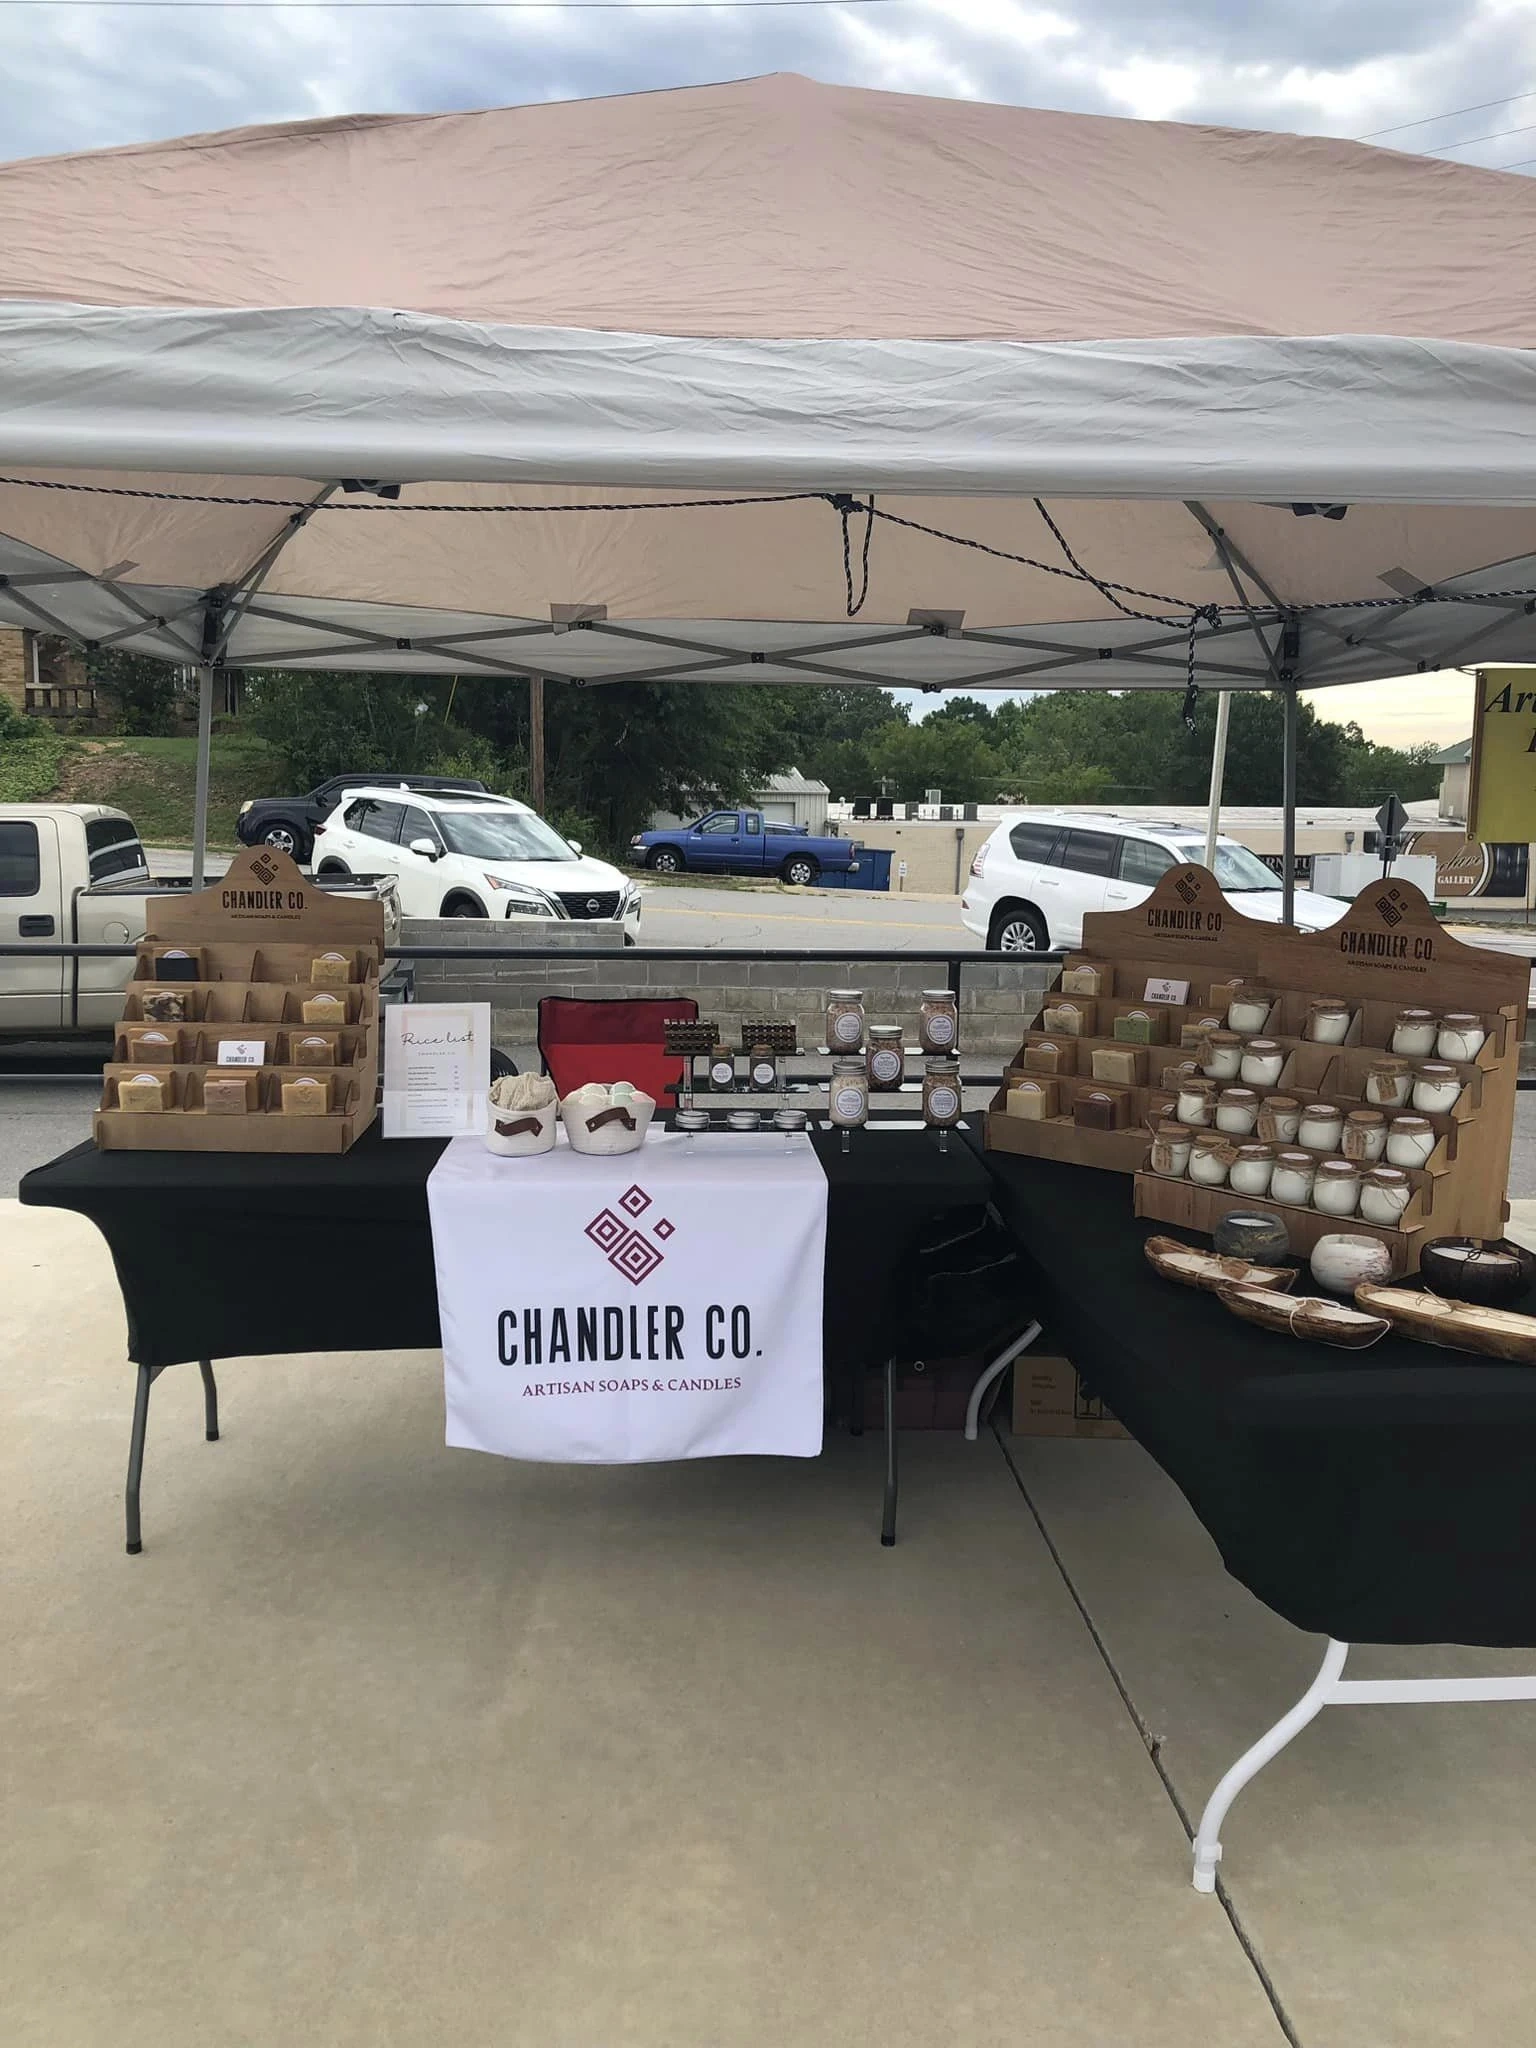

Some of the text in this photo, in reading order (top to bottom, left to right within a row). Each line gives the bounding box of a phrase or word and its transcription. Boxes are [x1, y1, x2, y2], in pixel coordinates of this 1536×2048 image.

[1437, 875, 1476, 885] GALLERY
[222, 890, 308, 910] CHANDLER CO.
[1147, 908, 1225, 932] CHANDLER CO.
[1340, 931, 1437, 961] CHANDLER CO.
[497, 1304, 763, 1366] CHANDLER CO.
[522, 1376, 742, 1397] ARTISAN SOAPS & CANDLES
